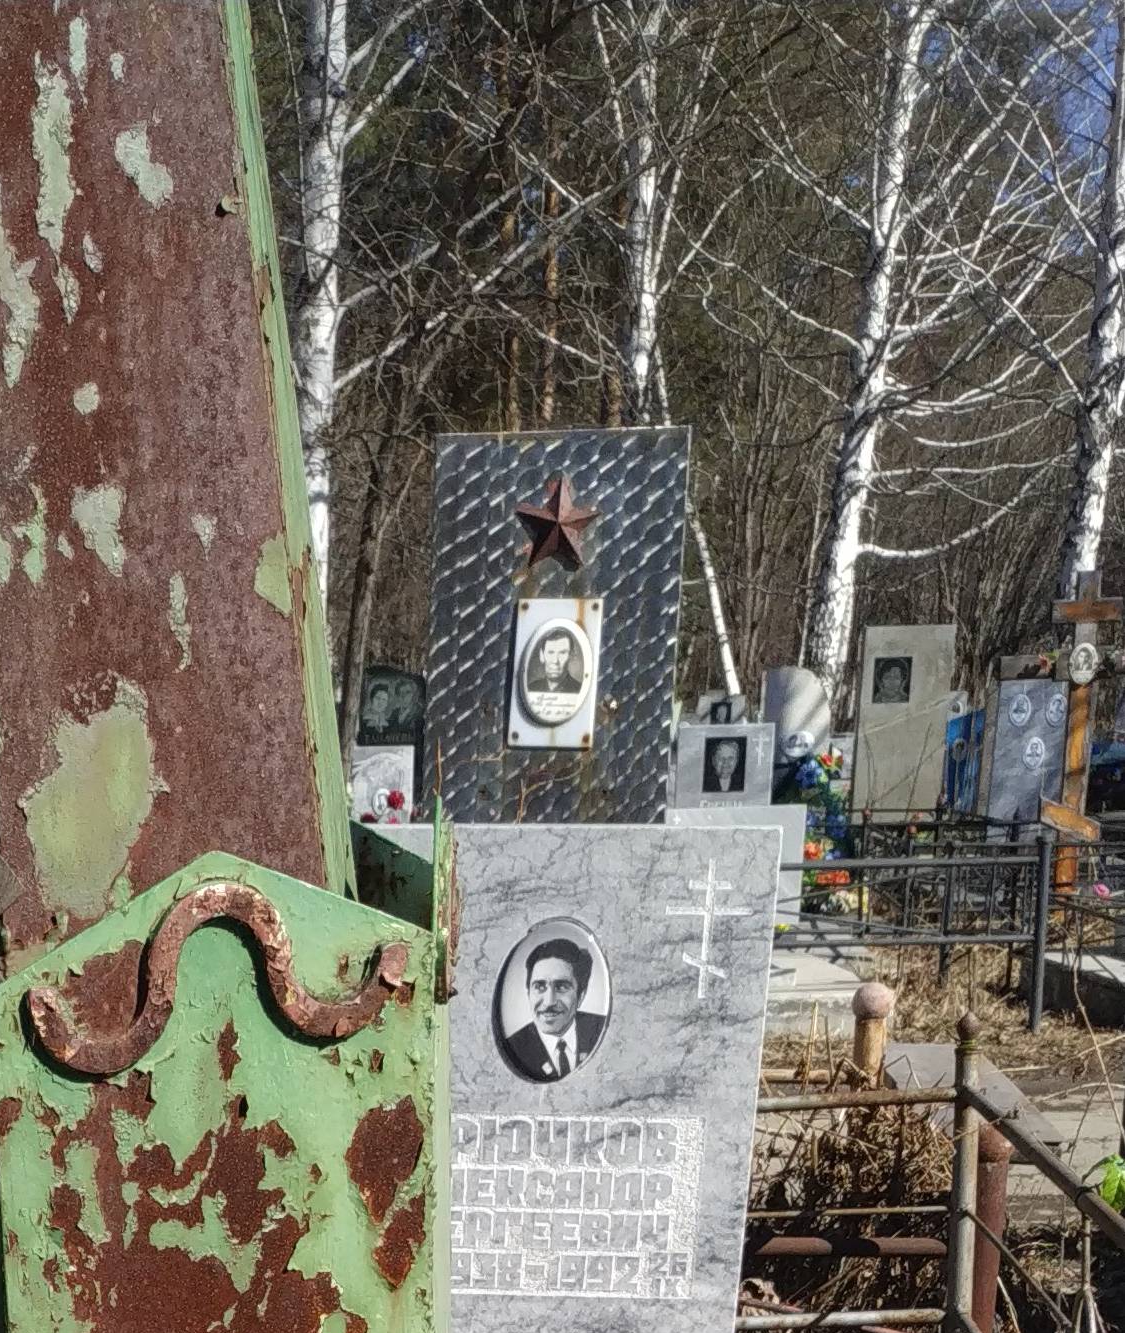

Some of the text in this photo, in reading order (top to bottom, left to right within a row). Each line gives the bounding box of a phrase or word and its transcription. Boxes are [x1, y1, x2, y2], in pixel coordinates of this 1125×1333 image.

[451, 1118, 678, 1167] РЮЧКОВ
[451, 1169, 674, 1210] ЕКСАНДР
[451, 1210, 672, 1251] РГЕЕВИЧ
